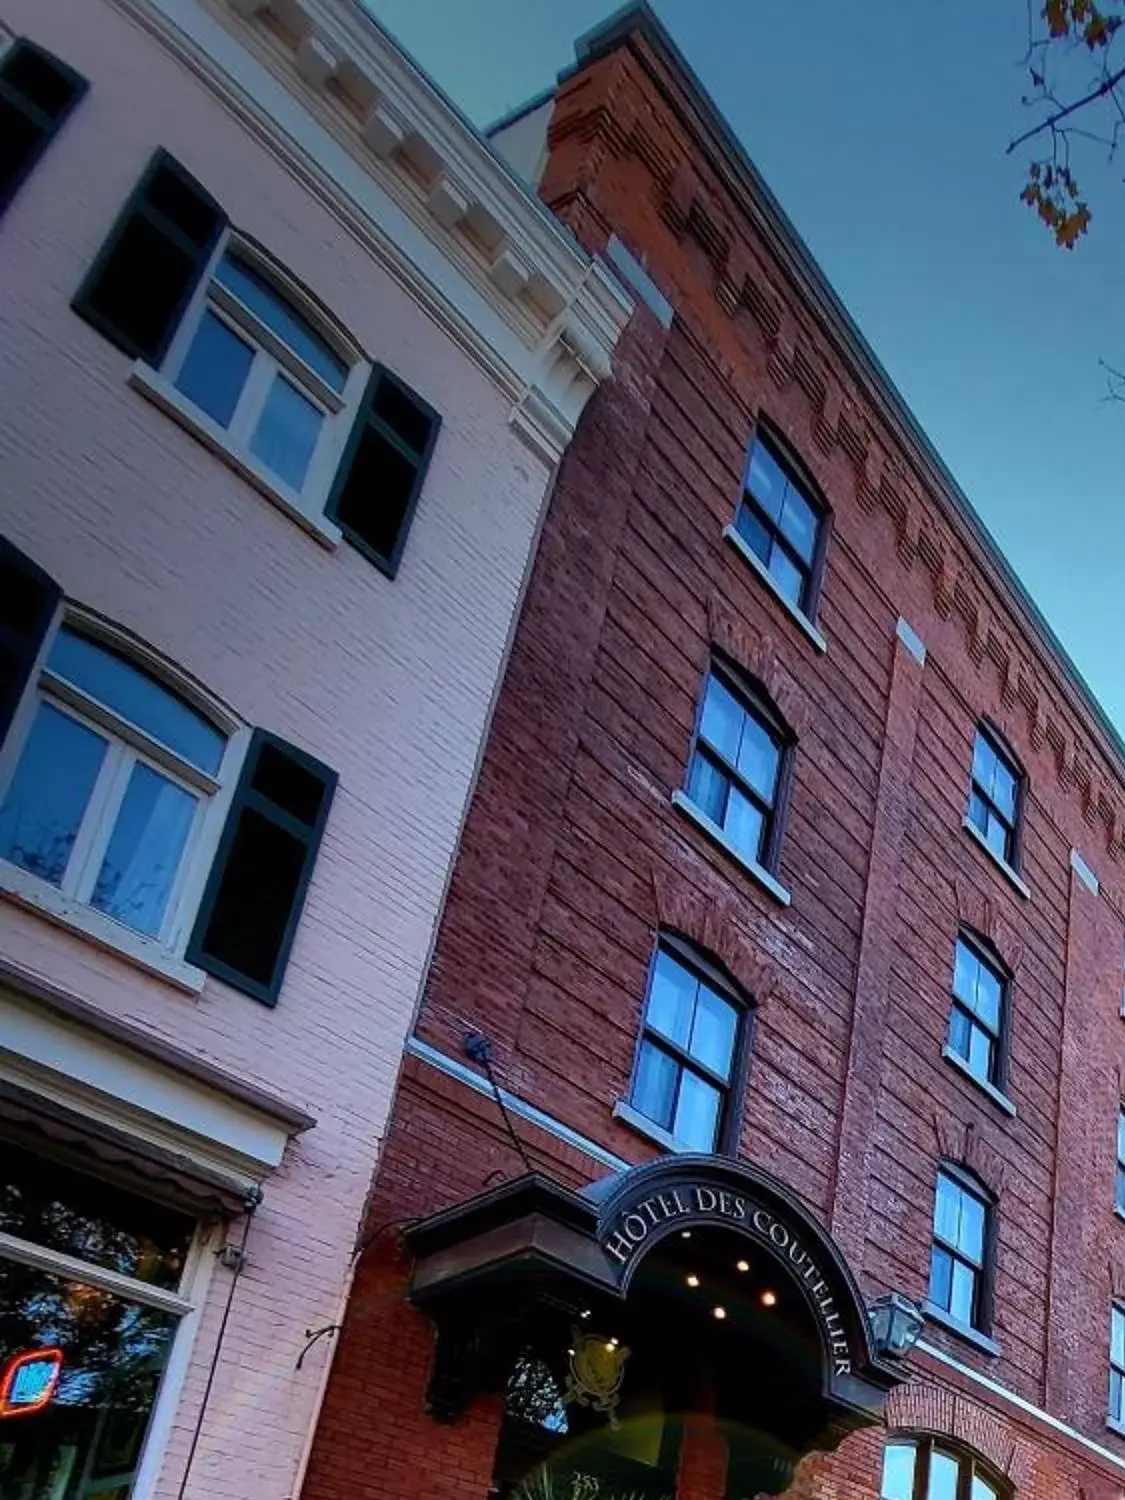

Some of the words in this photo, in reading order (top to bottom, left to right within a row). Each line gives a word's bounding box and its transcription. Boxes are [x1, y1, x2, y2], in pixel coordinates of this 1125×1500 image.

[605, 1189, 691, 1265] HÔTEL
[696, 1187, 746, 1219] DES
[753, 1210, 852, 1377] COUTELLIER
